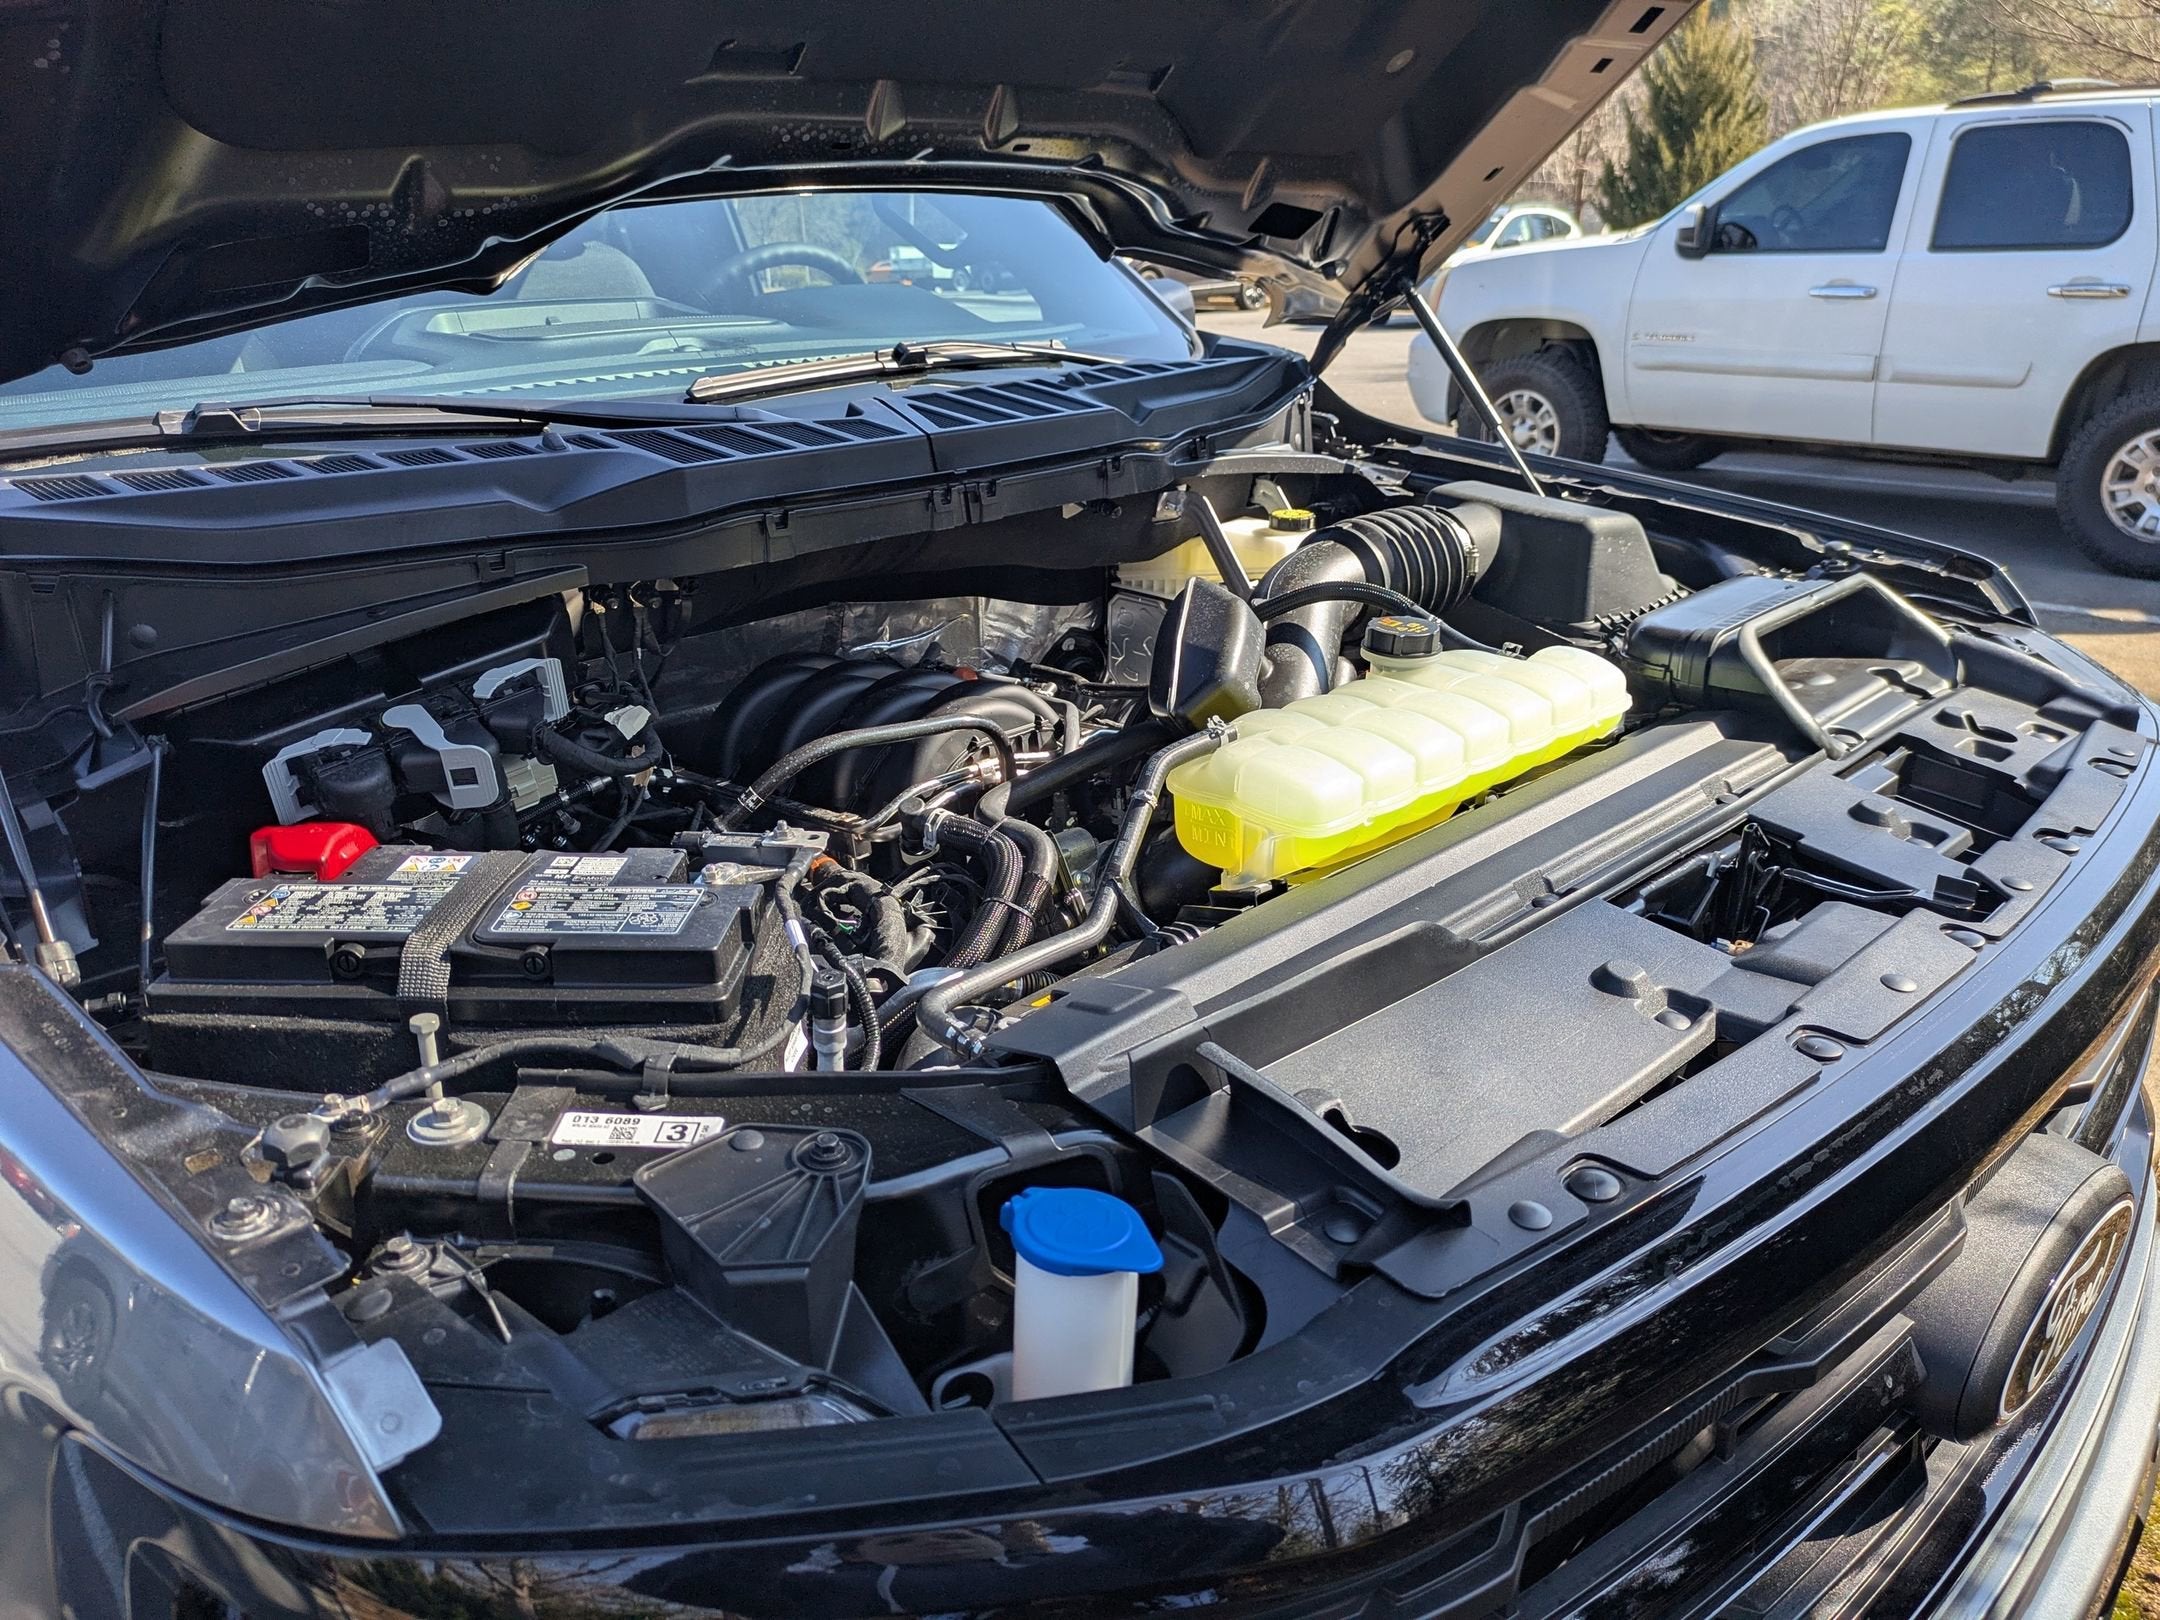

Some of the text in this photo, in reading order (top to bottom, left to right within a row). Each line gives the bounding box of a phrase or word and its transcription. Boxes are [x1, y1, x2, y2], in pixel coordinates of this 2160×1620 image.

[1191, 803, 1225, 826] MAX
[1191, 826, 1226, 847] MIN
[572, 1115, 641, 1125] 013 6089
[666, 1124, 689, 1142] 3
[2028, 1233, 2117, 1392] Ford
